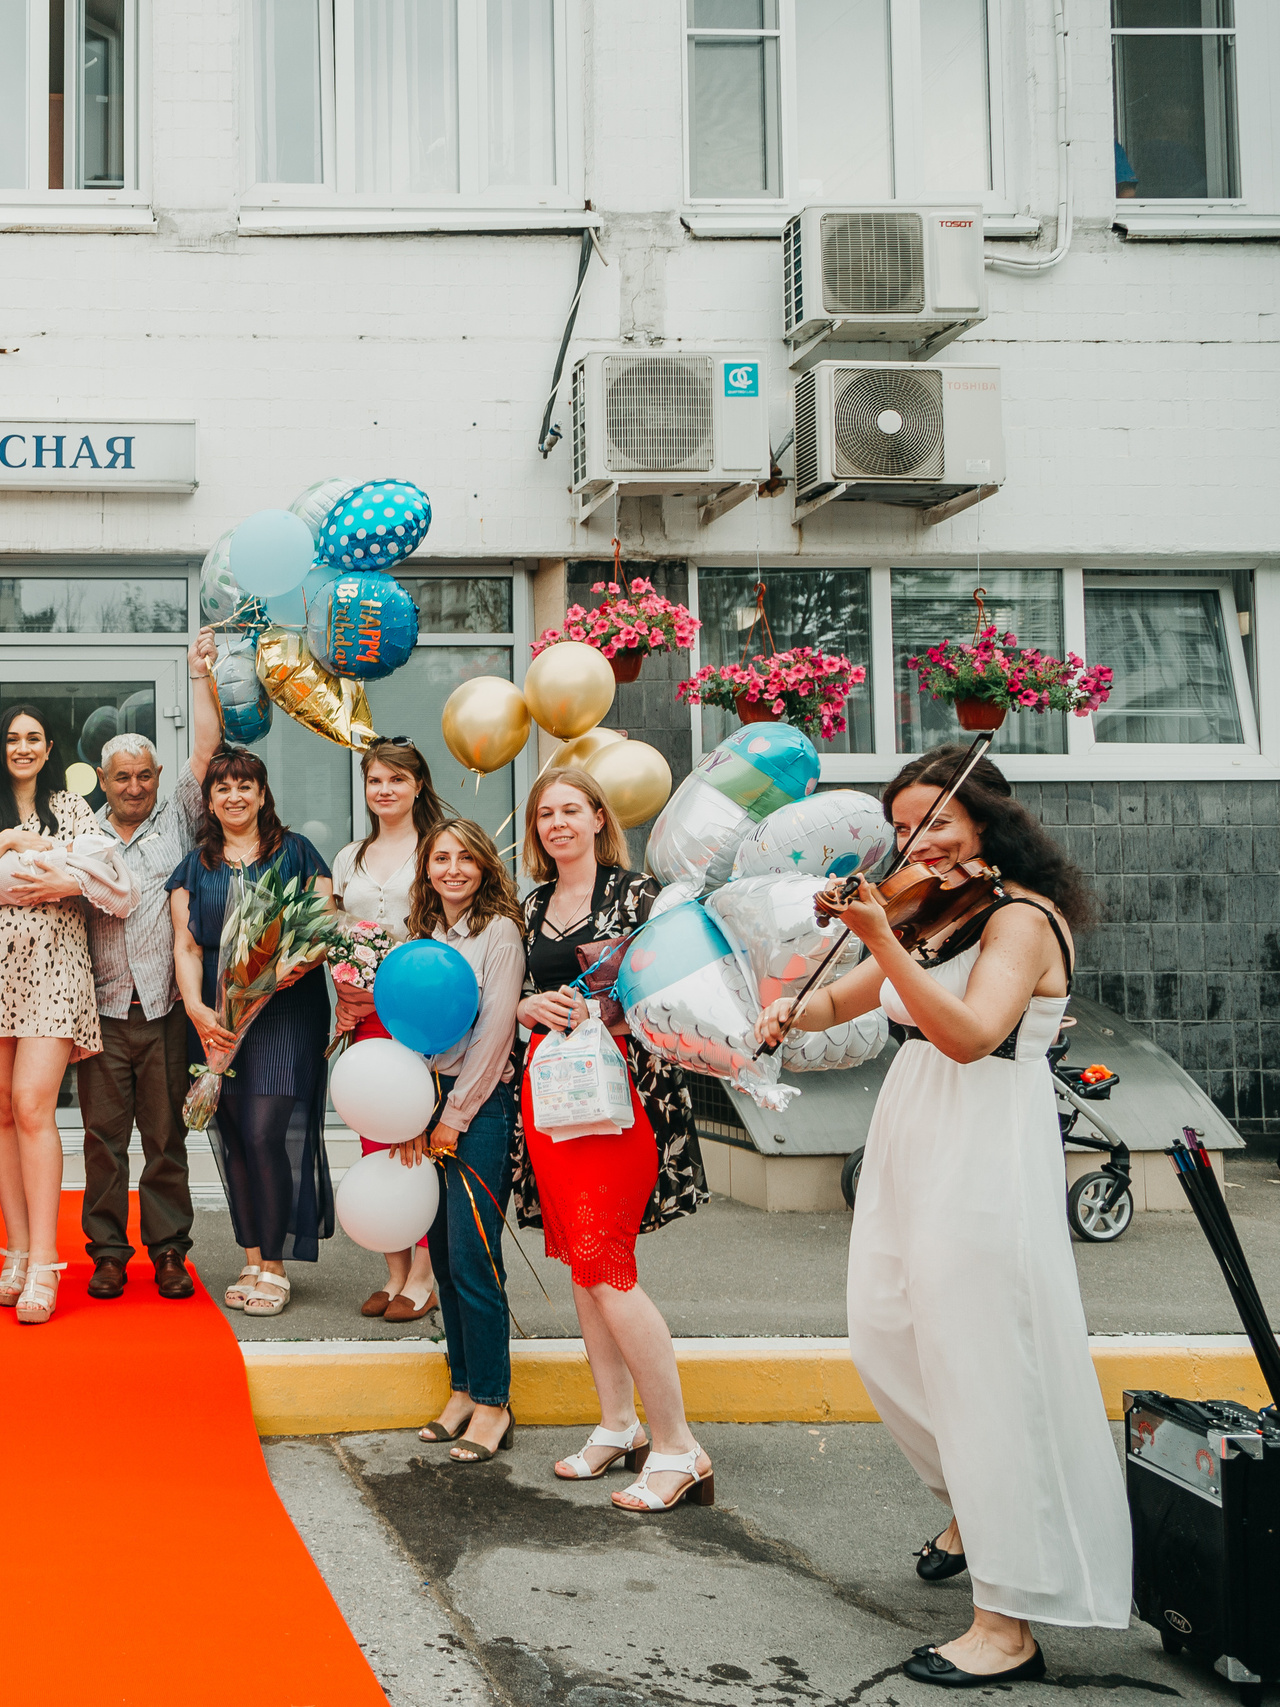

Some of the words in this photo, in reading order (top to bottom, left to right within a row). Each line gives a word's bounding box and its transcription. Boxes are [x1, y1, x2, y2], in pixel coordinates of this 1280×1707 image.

[939, 220, 974, 228] TOSOT
[946, 381, 997, 391] TOSHIBA
[356, 600, 382, 663] HAPPY
[697, 749, 734, 774] OY
